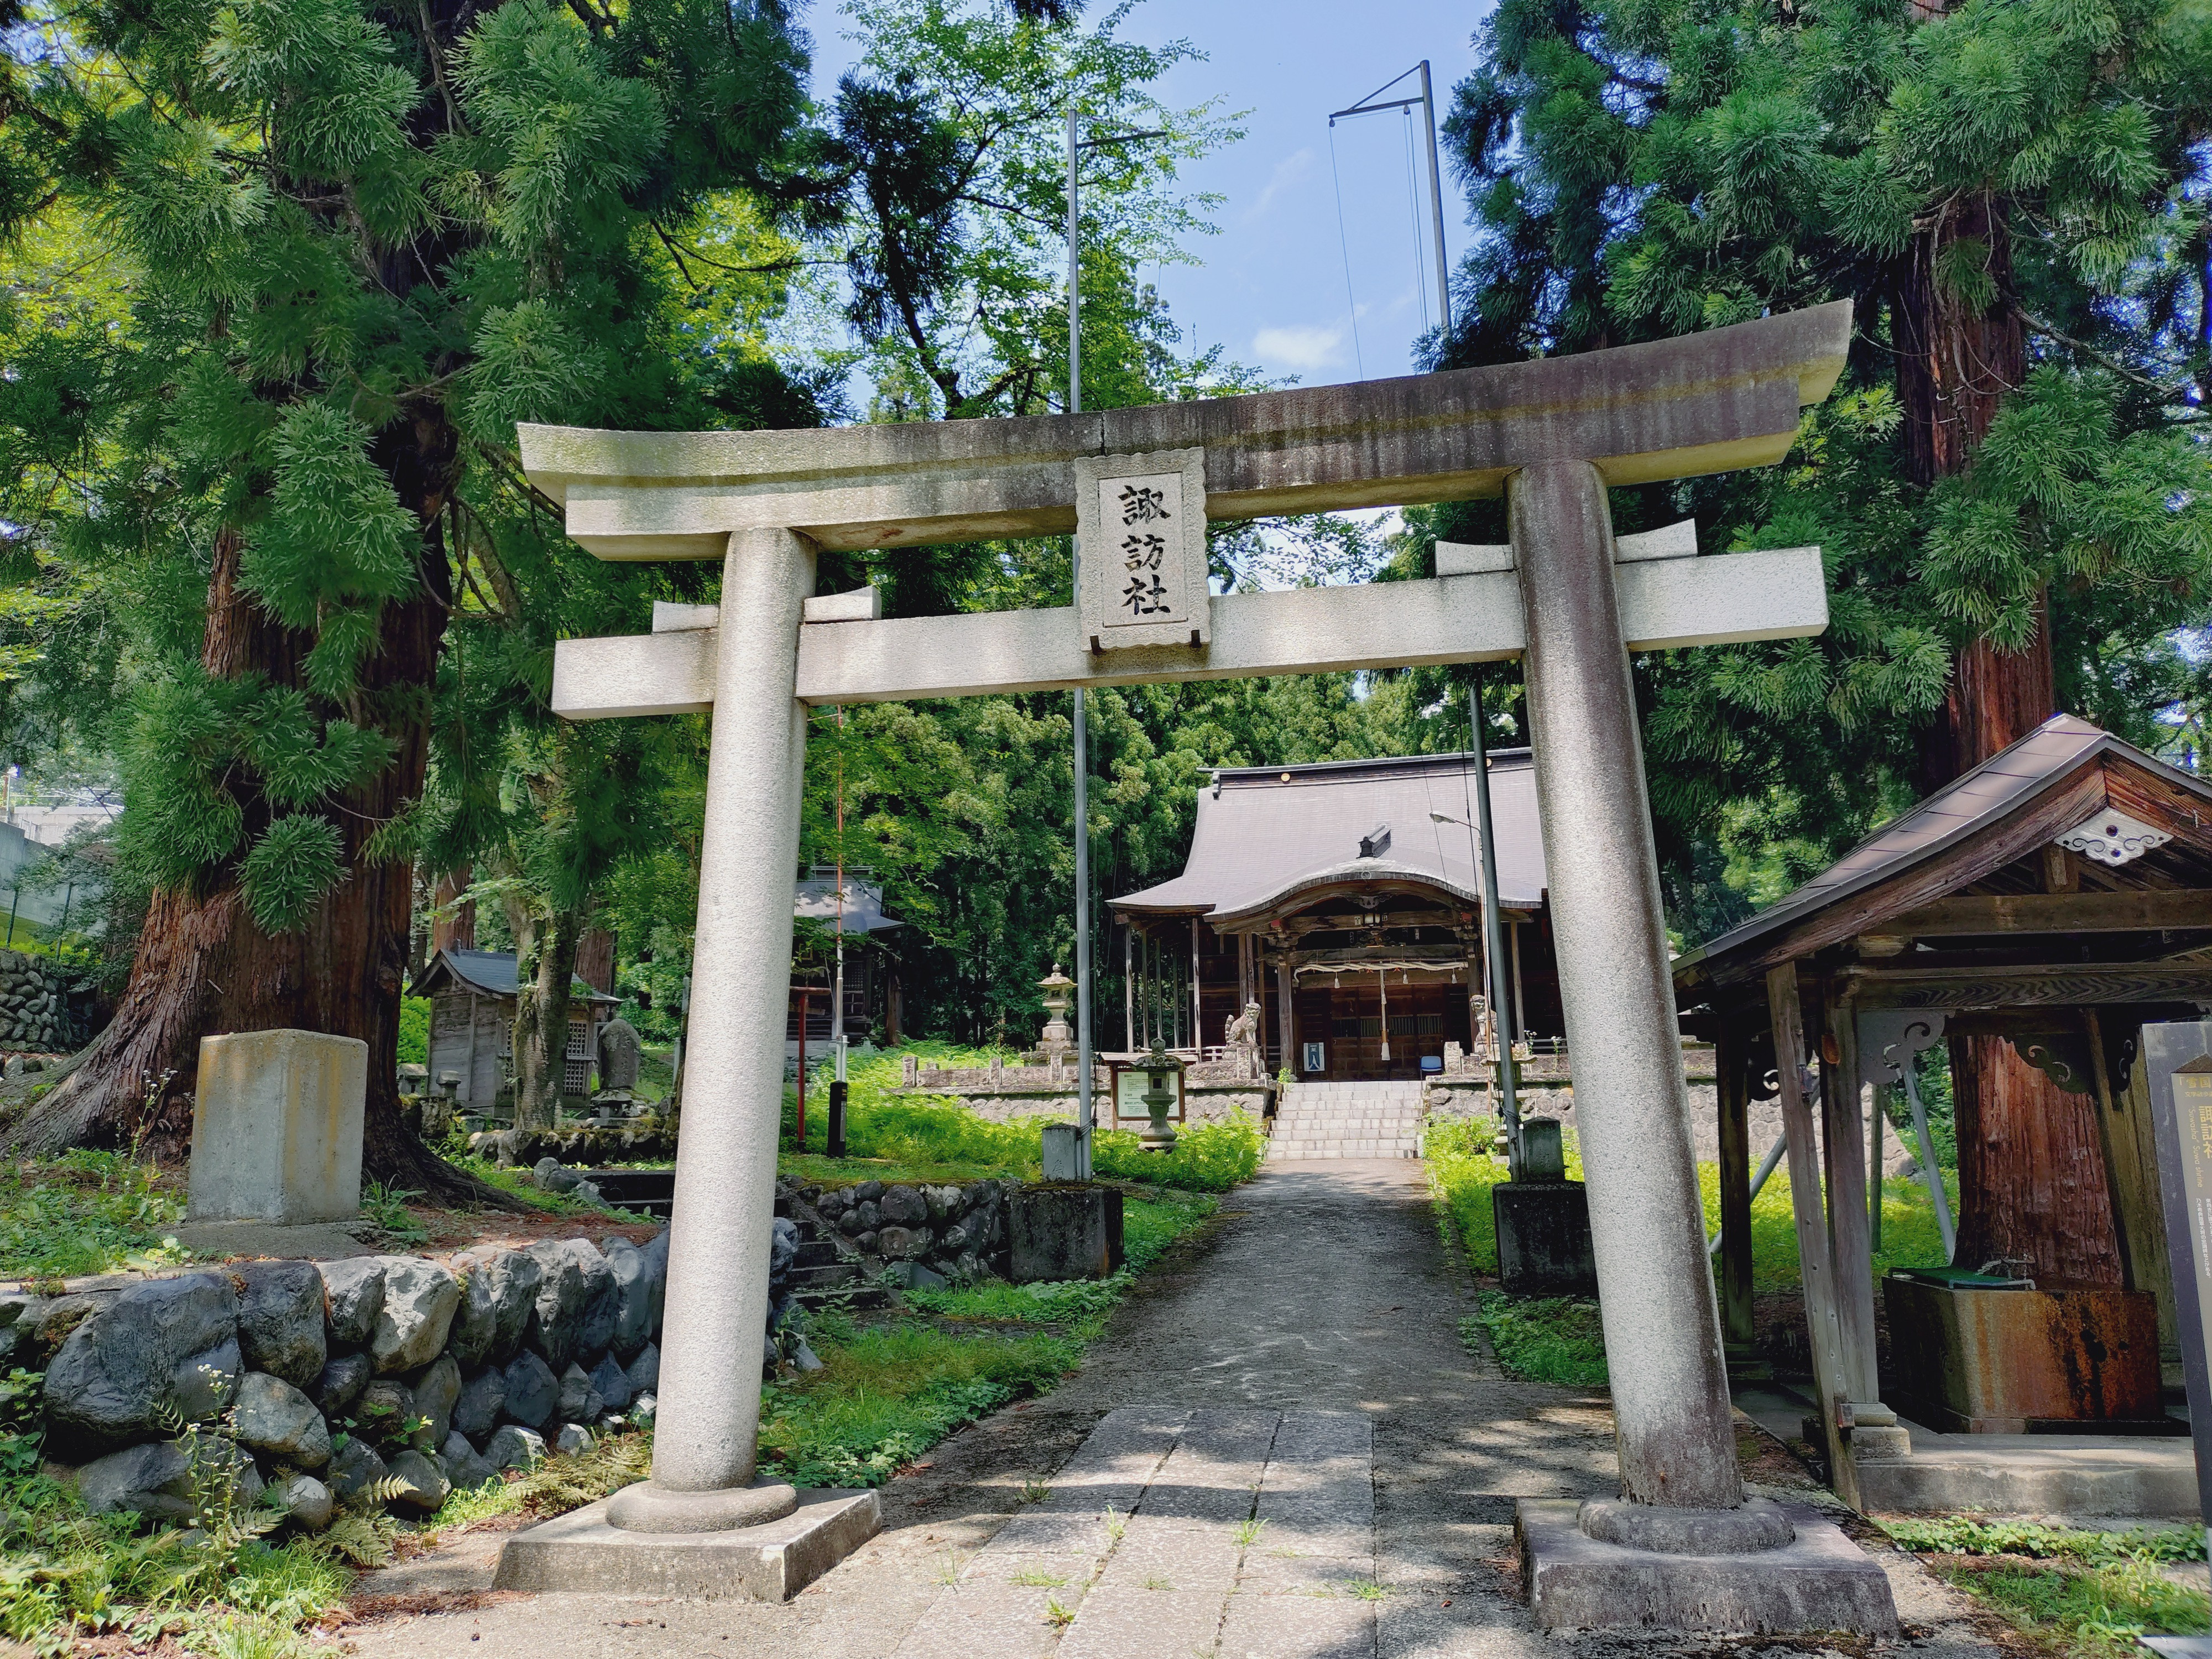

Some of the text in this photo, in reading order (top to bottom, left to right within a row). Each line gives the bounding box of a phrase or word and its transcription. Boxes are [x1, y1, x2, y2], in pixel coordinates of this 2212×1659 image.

[1118, 484, 1172, 616] 諏訪社
[2195, 1167, 2204, 1188] shrine
